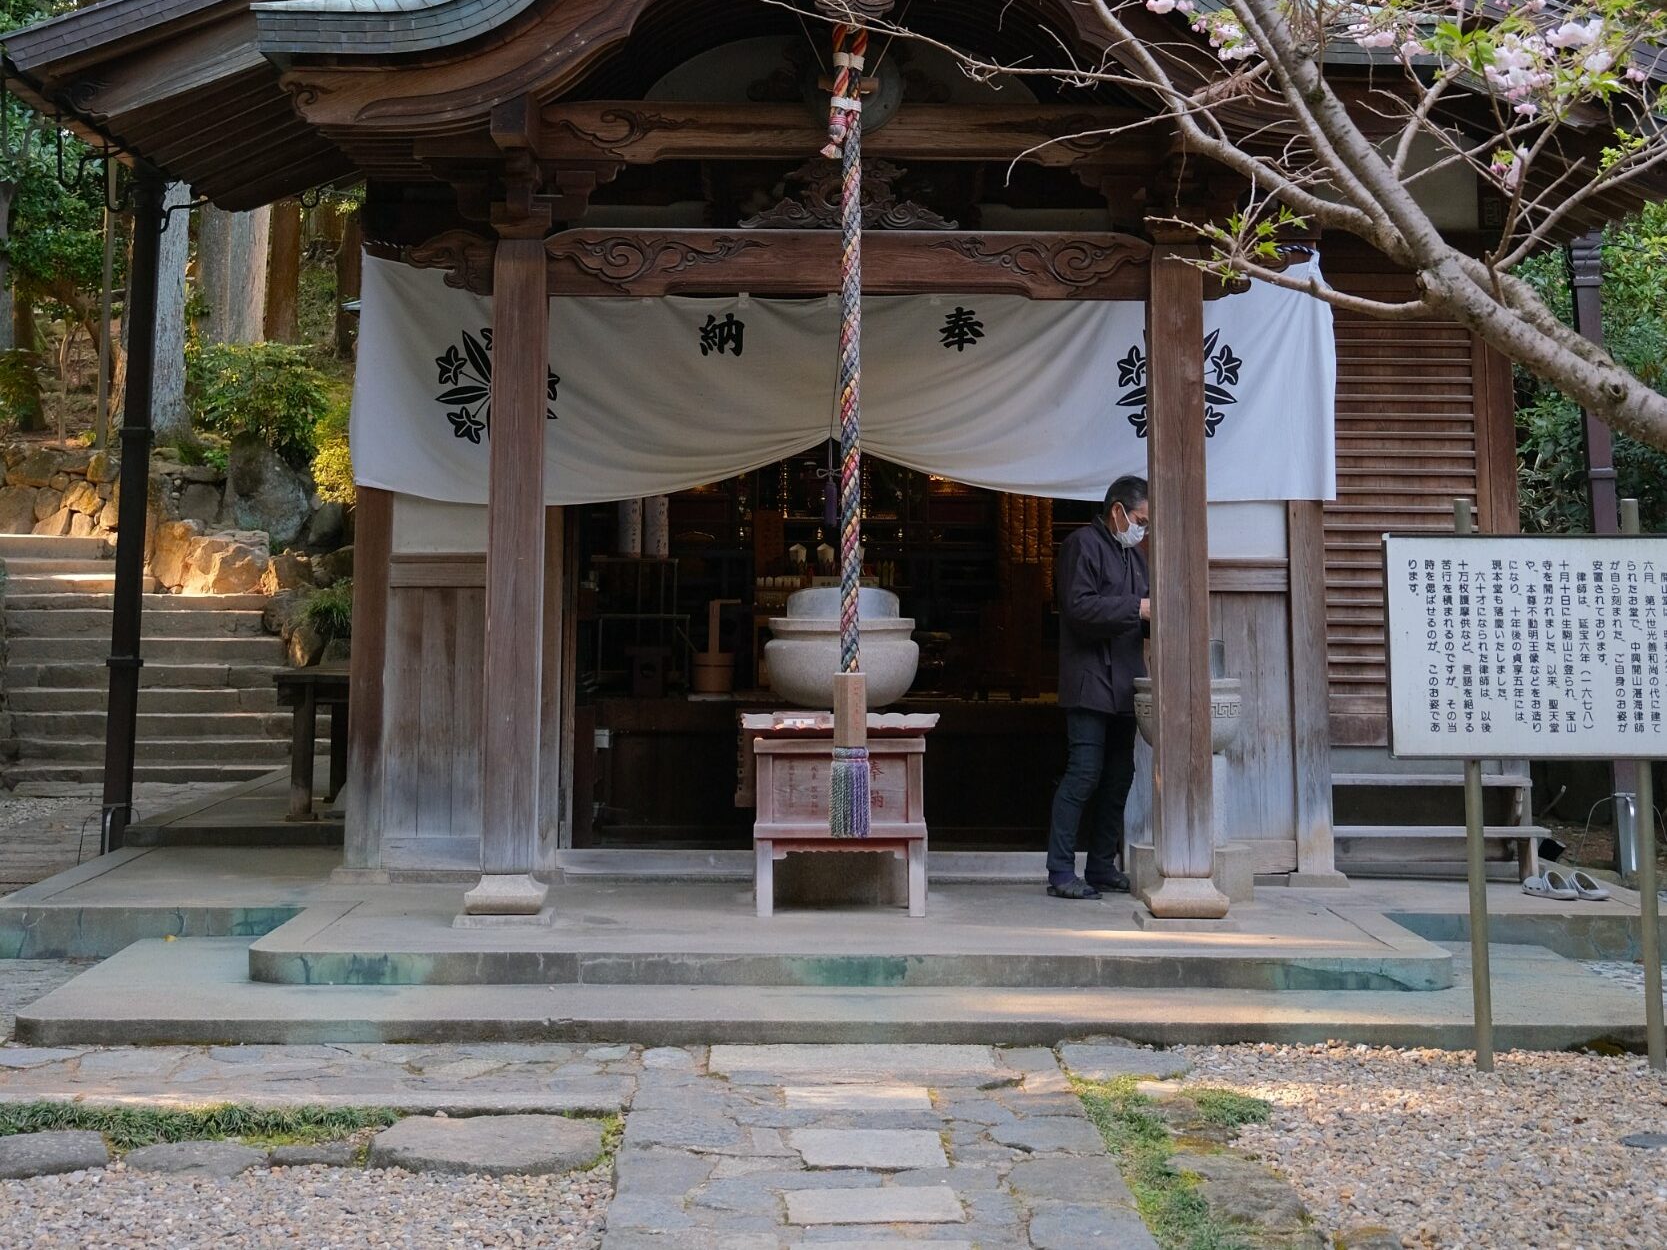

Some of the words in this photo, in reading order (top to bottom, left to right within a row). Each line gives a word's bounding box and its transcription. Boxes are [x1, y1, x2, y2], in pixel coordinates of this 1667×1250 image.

[699, 312, 745, 356] 納
[939, 307, 985, 352] 奉
[1408, 560, 1419, 596] ります。
